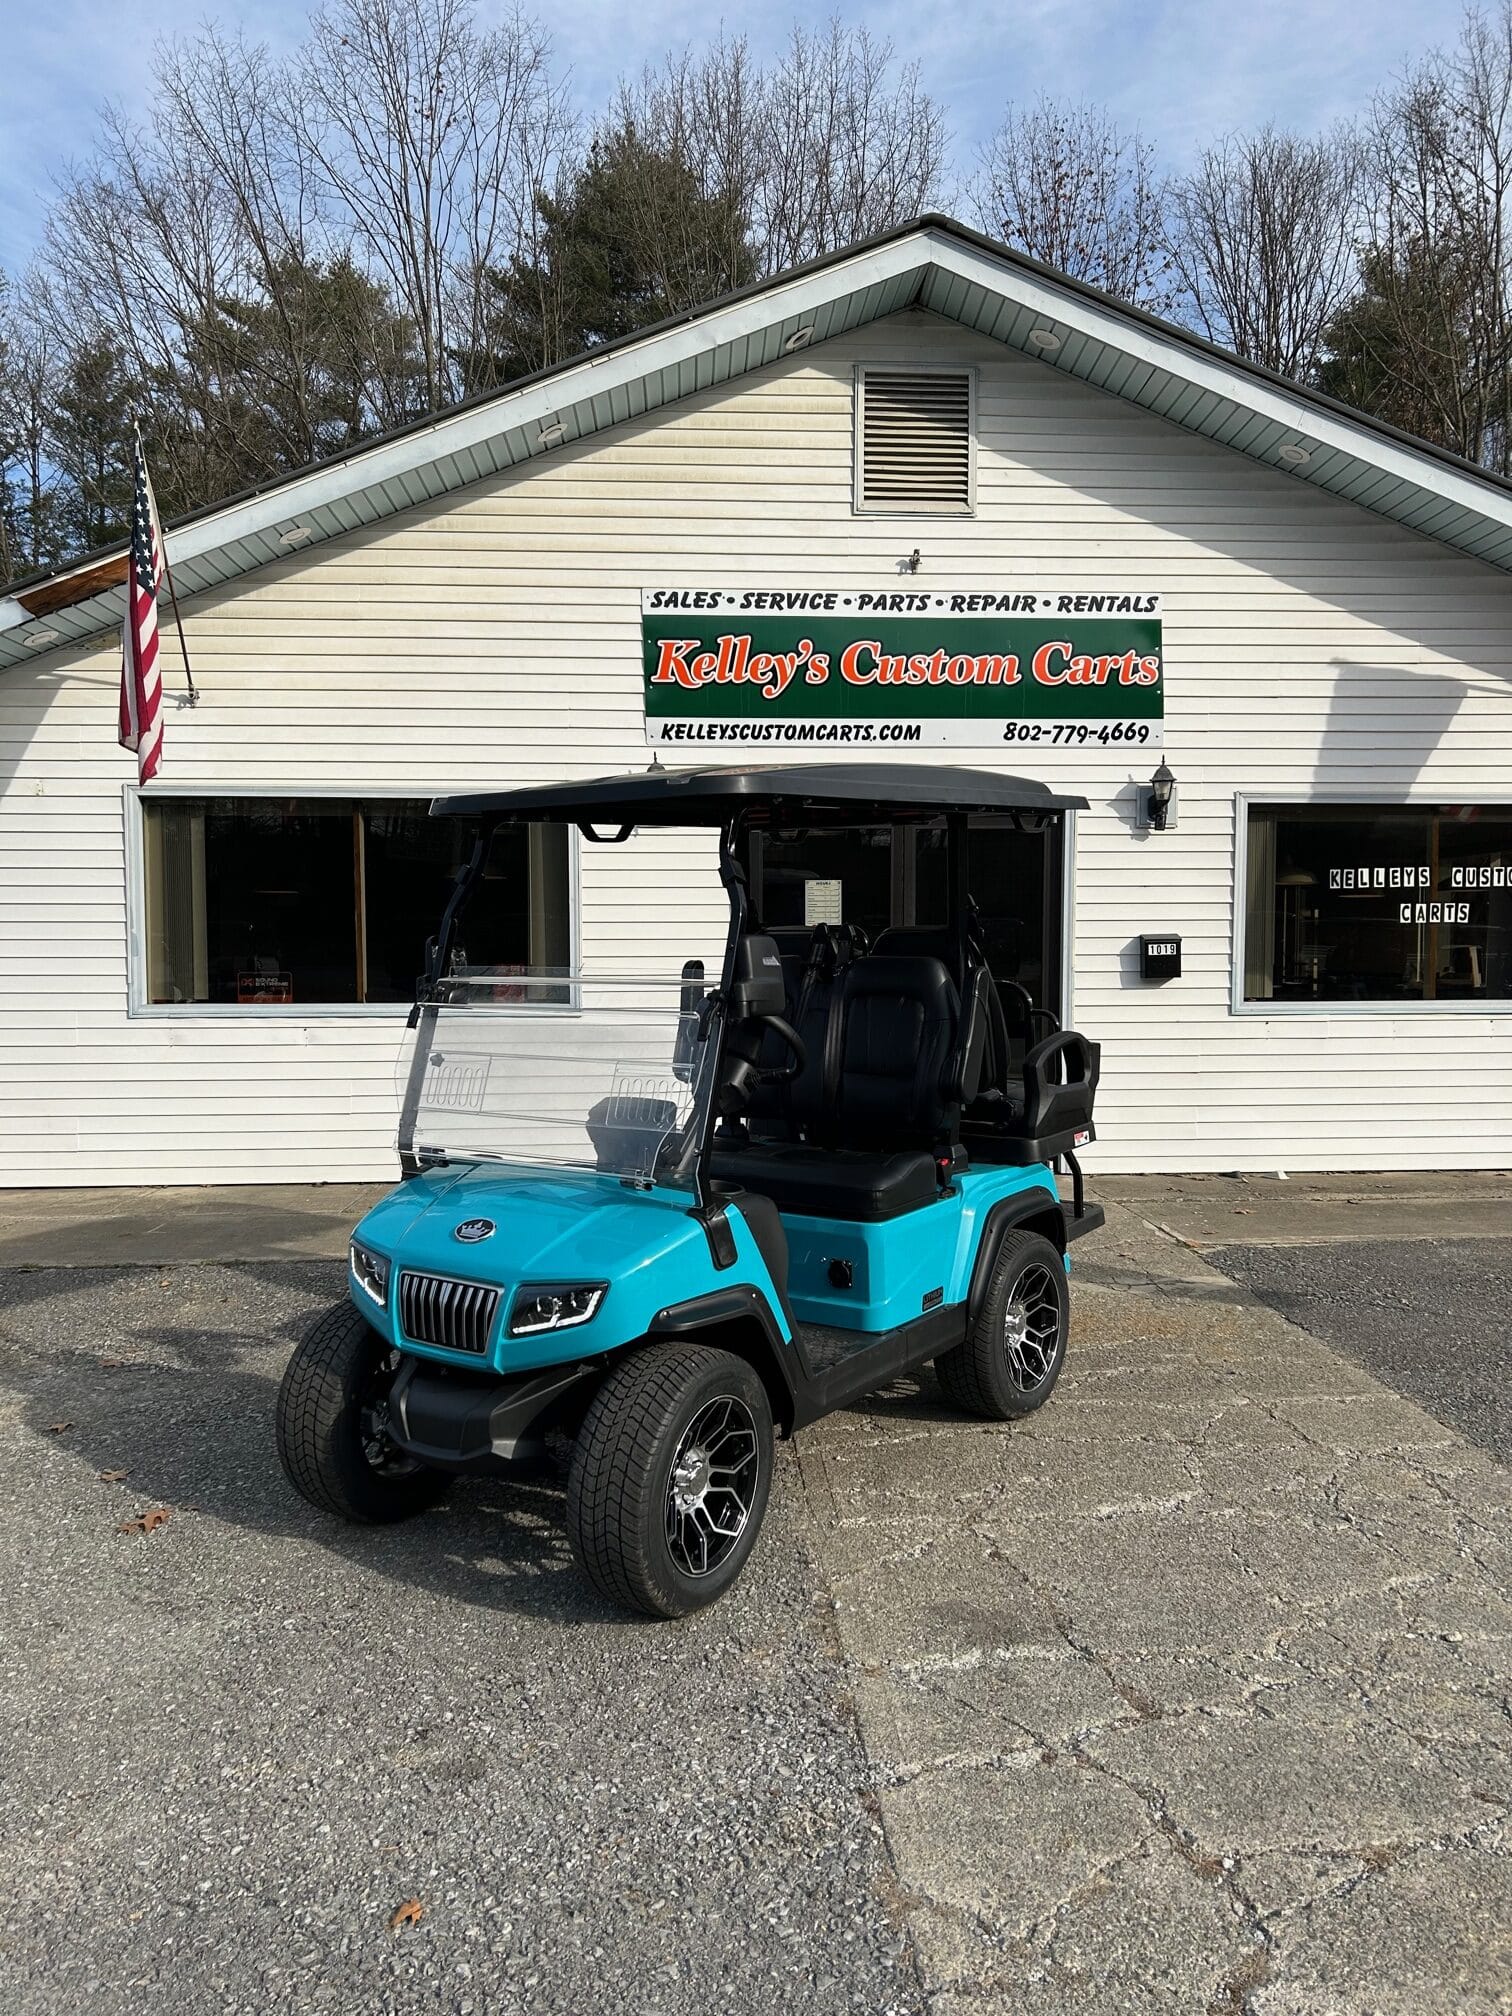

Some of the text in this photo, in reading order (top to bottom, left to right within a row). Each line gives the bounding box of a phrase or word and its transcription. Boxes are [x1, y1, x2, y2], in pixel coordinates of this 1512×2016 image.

[650, 591, 1159, 613] SALES SERVICE PARTS REPAIR RENTALS
[651, 634, 1160, 699] Kelley's Custom Carts
[660, 723, 921, 742] KELLEYSCUSTOMCARTS.COM
[1003, 722, 1150, 745] 802-779-4669
[1330, 867, 1430, 888] KELLEYS
[1401, 904, 1469, 923] CARTS
[1150, 944, 1175, 955] 1019
